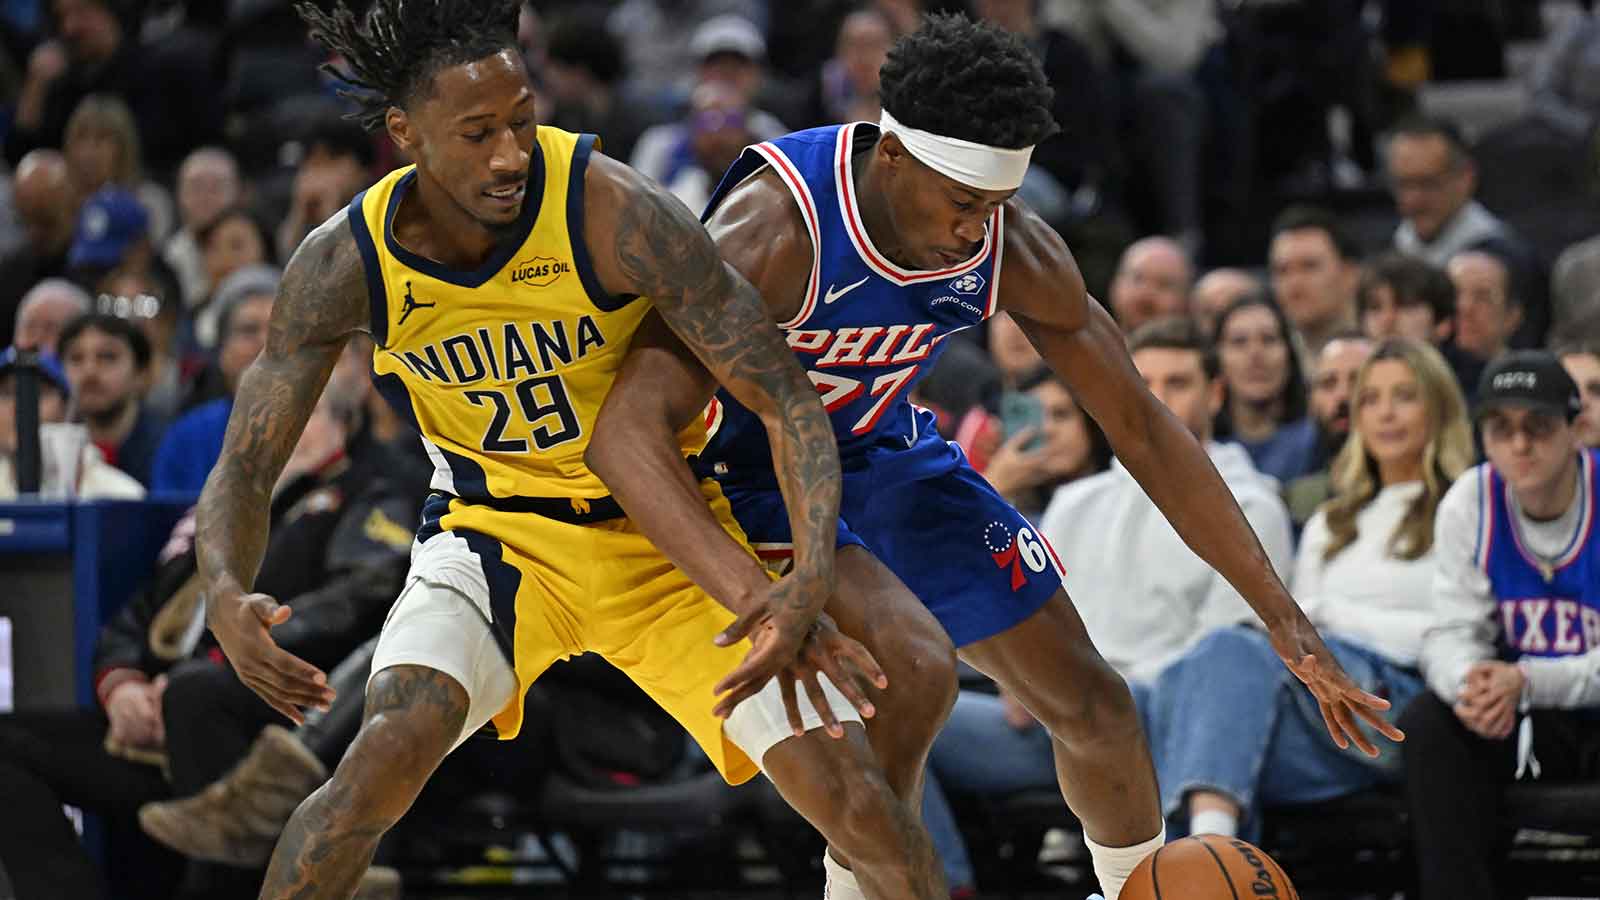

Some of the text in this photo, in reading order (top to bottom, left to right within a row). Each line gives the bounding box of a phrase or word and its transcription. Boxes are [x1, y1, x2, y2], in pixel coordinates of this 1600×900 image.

[511, 262, 570, 283] LUCAS OIL
[785, 323, 943, 368] PHIL
[463, 374, 582, 454] 29
